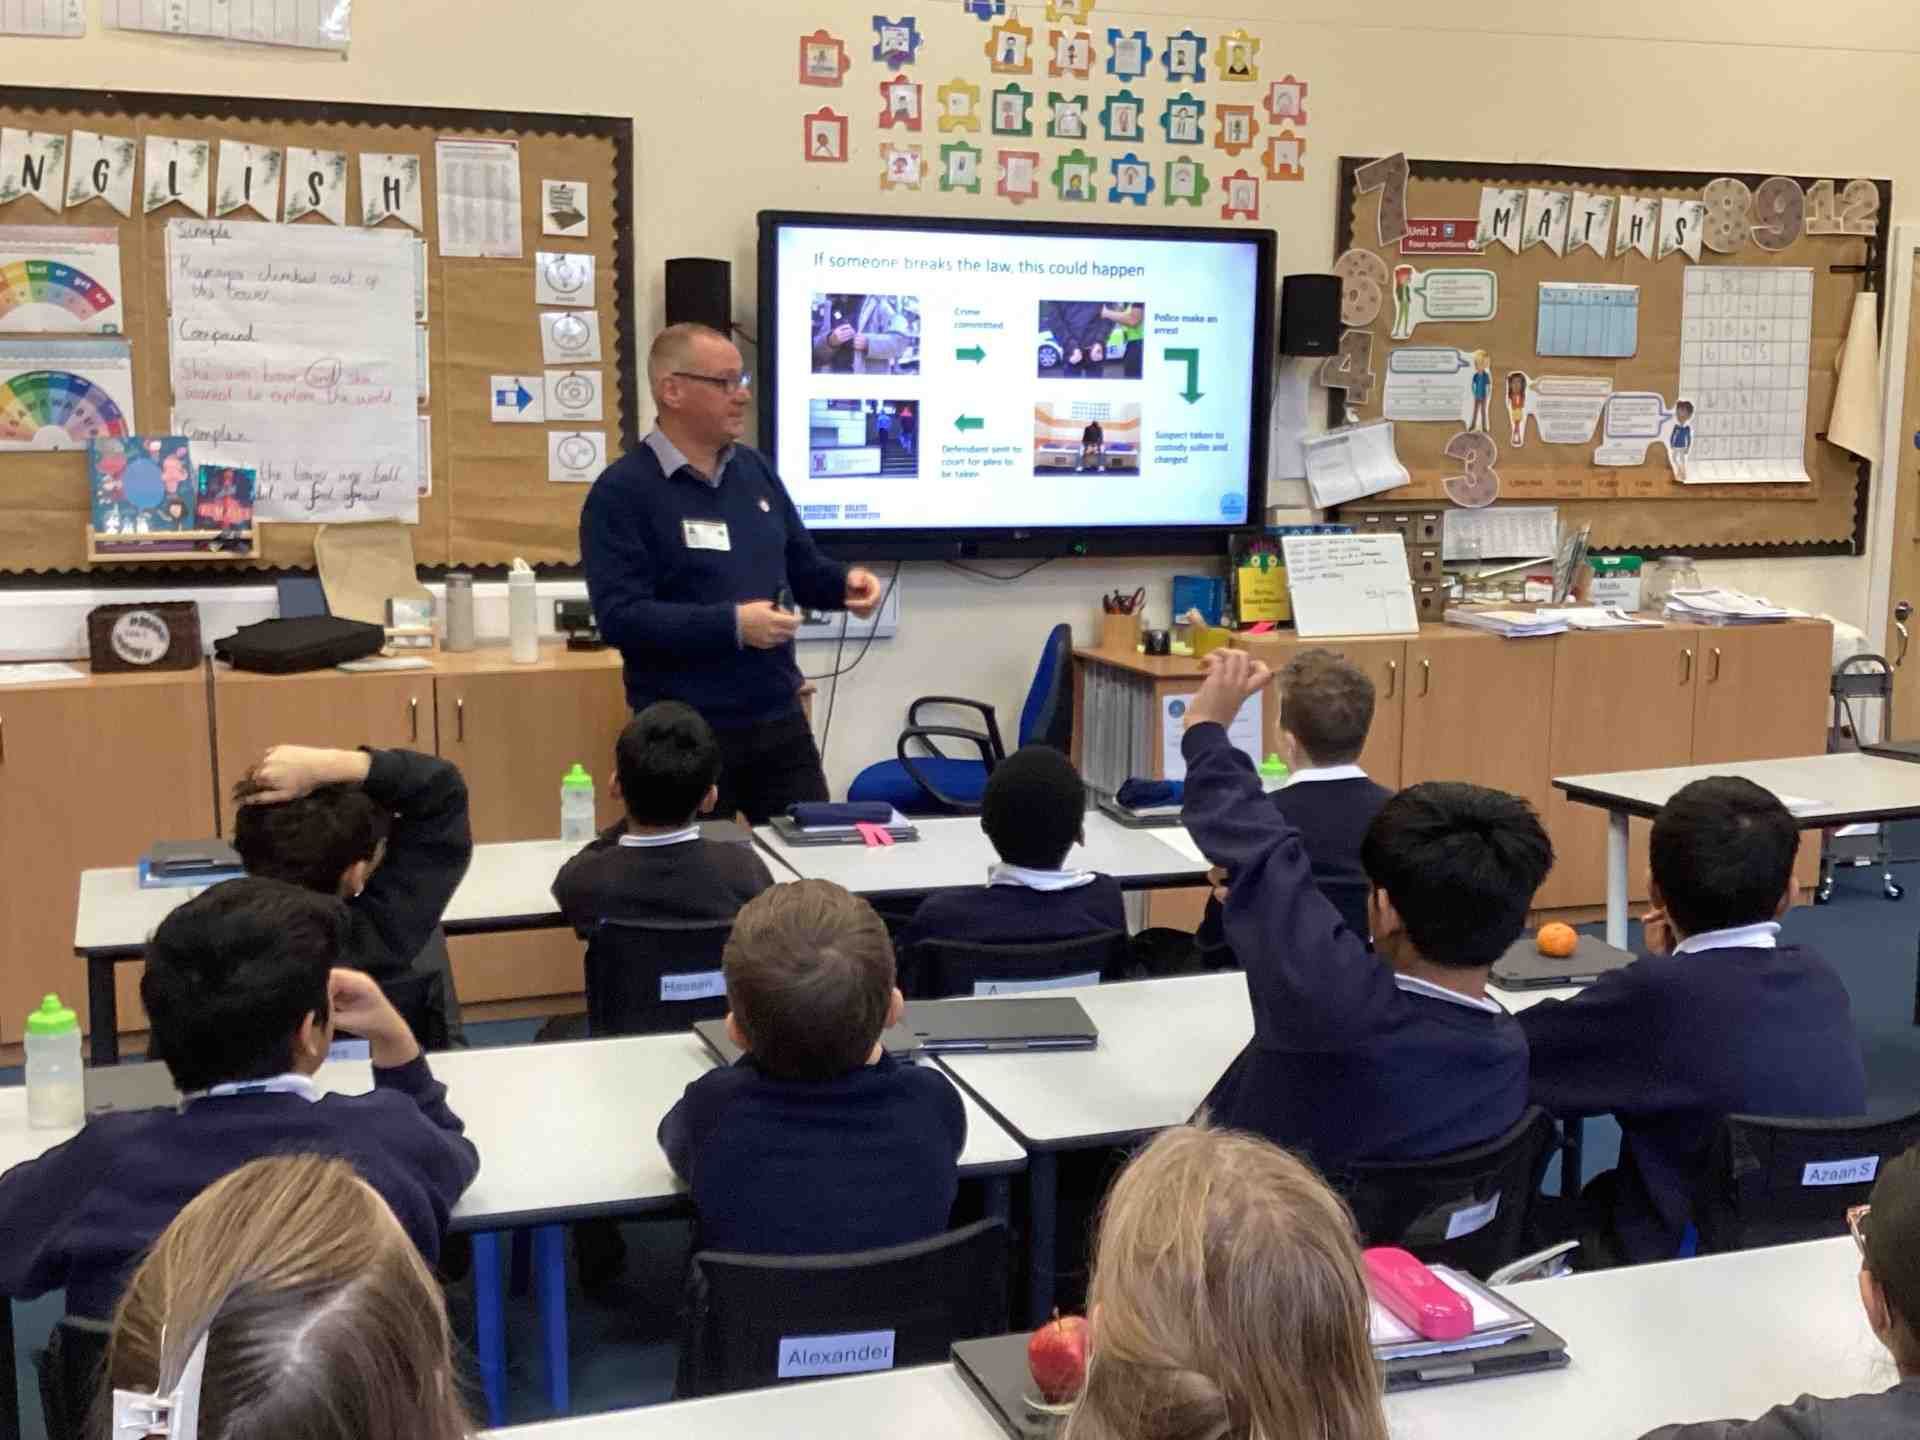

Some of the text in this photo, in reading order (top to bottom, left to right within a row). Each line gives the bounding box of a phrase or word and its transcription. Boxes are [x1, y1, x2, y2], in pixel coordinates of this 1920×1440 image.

[1408, 226, 1428, 237] Unit
[1492, 205, 1689, 247] MATHS
[813, 253, 824, 268] If
[829, 256, 899, 270] someone
[904, 256, 953, 272] breaks
[957, 258, 982, 272] the
[1019, 259, 1045, 275] this
[1049, 260, 1088, 276] could
[1092, 262, 1146, 279] happen
[1154, 313, 1180, 324] Police
[1181, 313, 1205, 323] make
[1859, 1162, 1872, 1176] S
[787, 1344, 890, 1367] Alexander
